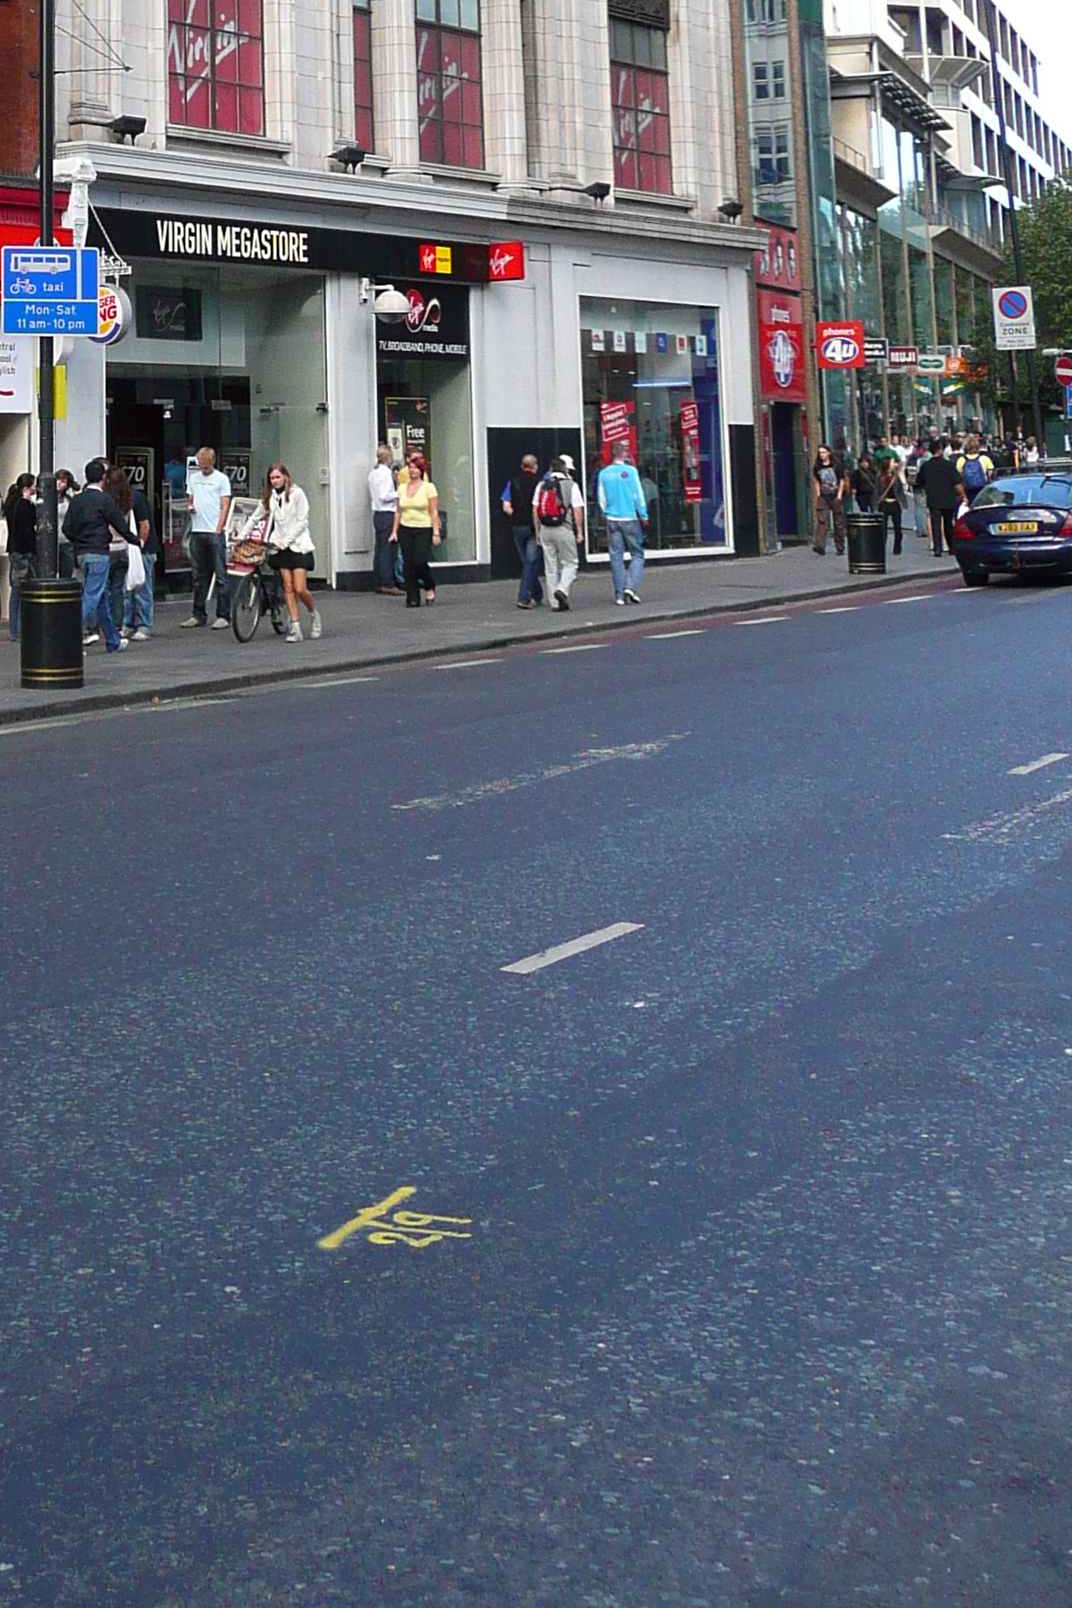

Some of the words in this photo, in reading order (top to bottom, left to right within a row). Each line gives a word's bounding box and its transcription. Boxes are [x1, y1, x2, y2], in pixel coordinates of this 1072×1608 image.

[156, 220, 213, 255] VIRGIN
[217, 225, 309, 263] MEGASTORE
[490, 248, 515, 276] Virgin
[43, 281, 64, 292] taxi
[17, 319, 26, 328] 11
[68, 321, 85, 330] pm
[822, 327, 856, 338] phones
[1002, 327, 1028, 335] ZONE
[890, 351, 916, 362] MUJI
[406, 425, 425, 439] Free
